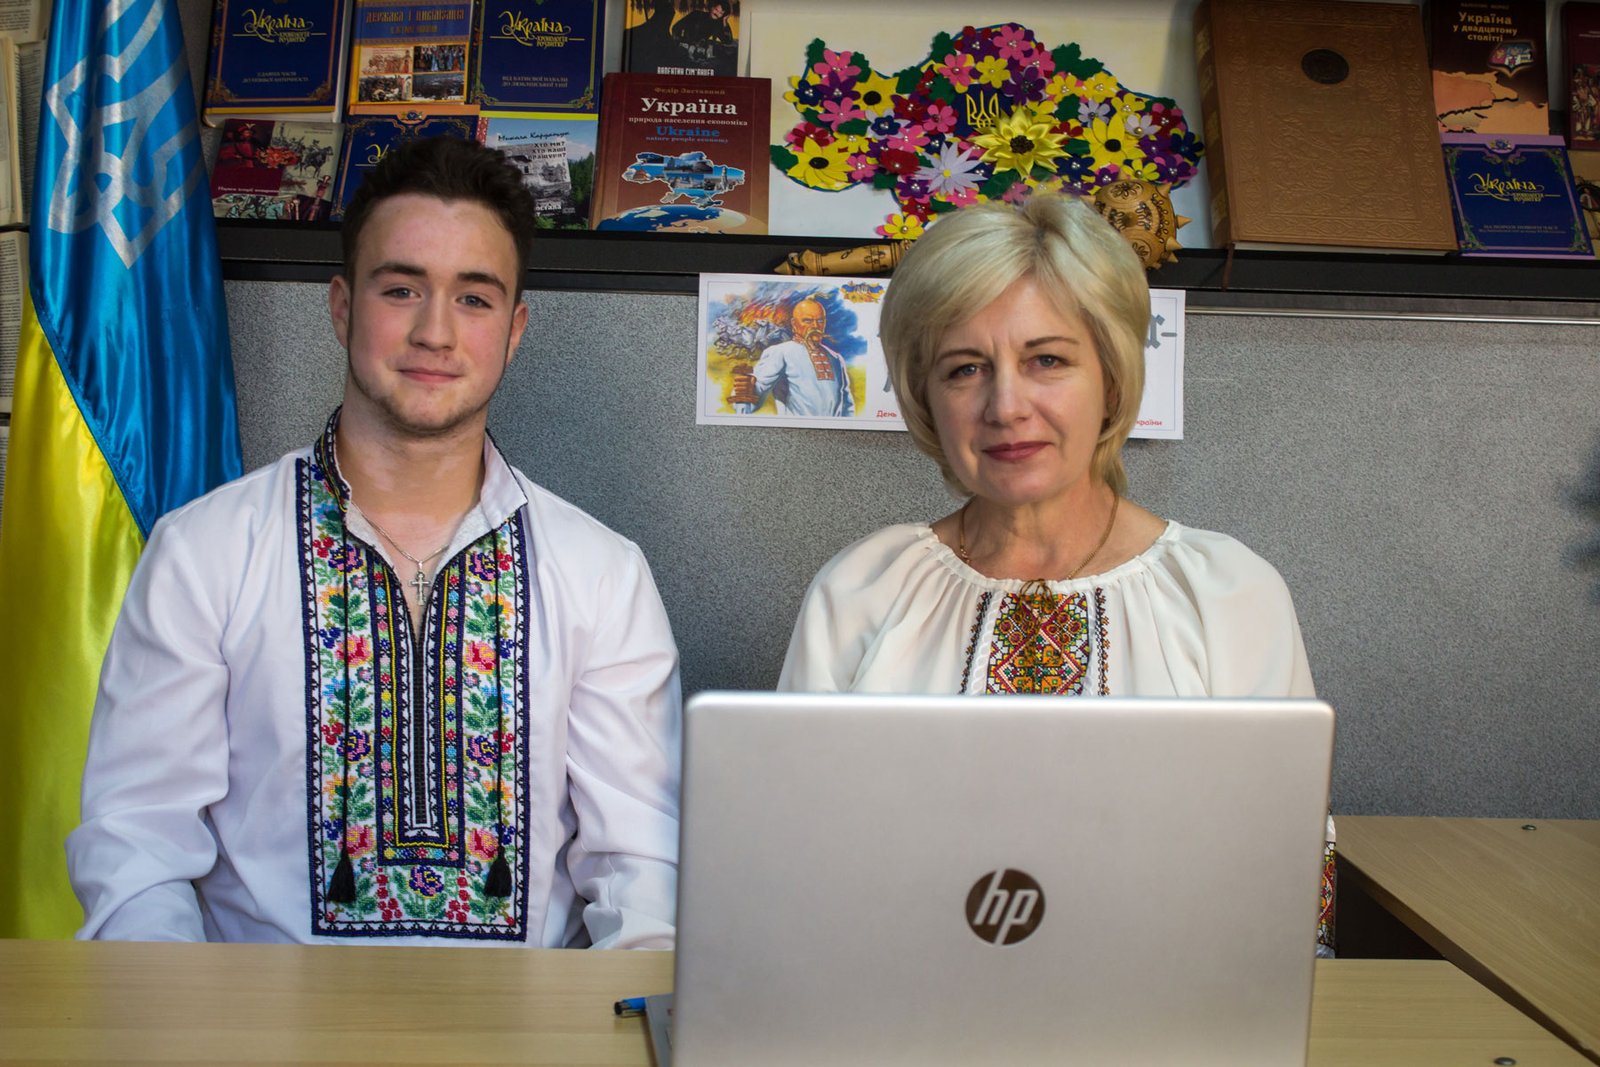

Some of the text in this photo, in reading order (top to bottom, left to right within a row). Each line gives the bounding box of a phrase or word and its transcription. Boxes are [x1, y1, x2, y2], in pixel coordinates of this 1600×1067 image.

[1458, 11, 1513, 25] Україна
[1467, 34, 1504, 42] столітті
[641, 97, 738, 117] Україна
[656, 125, 720, 137] Ukraine
[876, 410, 897, 418] День
[971, 868, 1040, 946] hp
